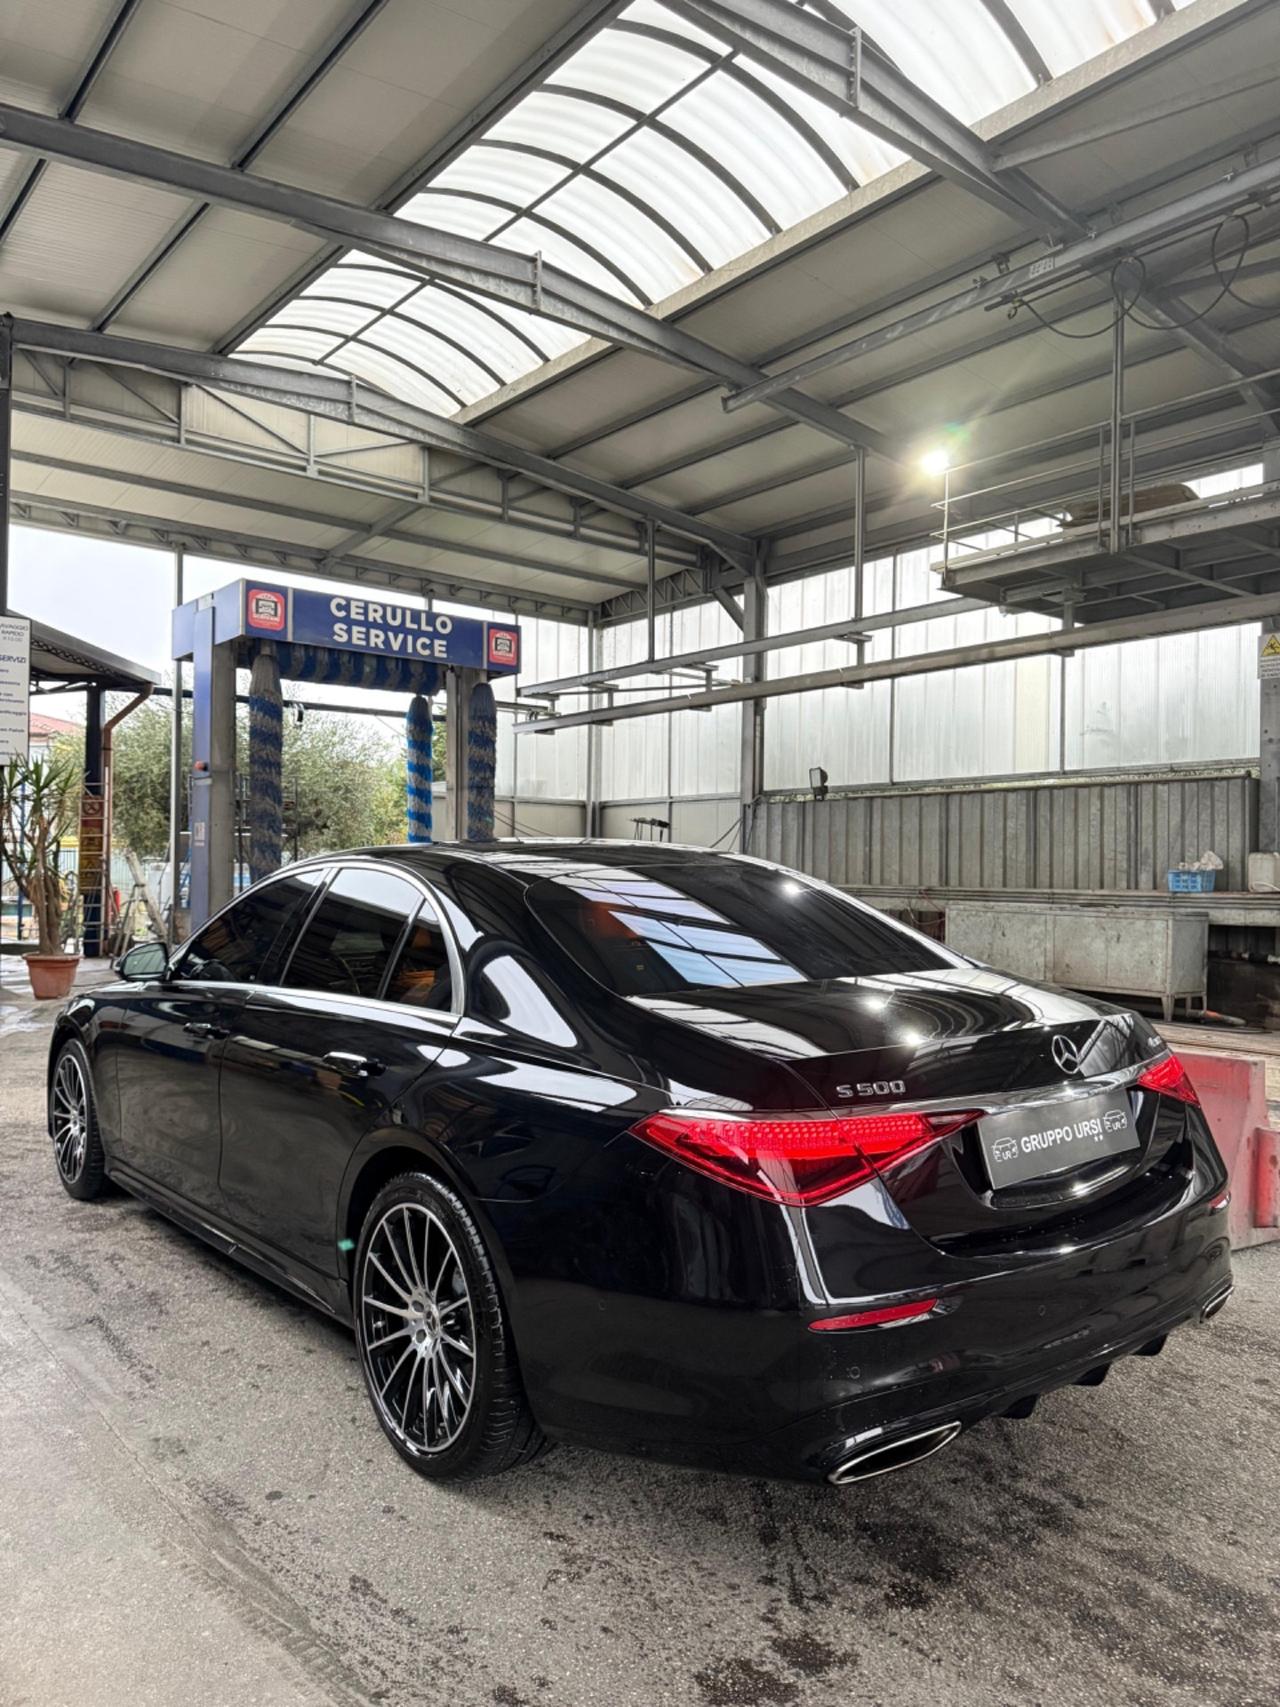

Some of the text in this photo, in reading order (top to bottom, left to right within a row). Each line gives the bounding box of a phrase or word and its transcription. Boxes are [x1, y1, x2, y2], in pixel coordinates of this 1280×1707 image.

[330, 597, 452, 634] CERULLO
[333, 622, 447, 658] SERVICE
[836, 1080, 906, 1098] S 500
[1021, 1118, 1102, 1153] GRUPPO URSI
